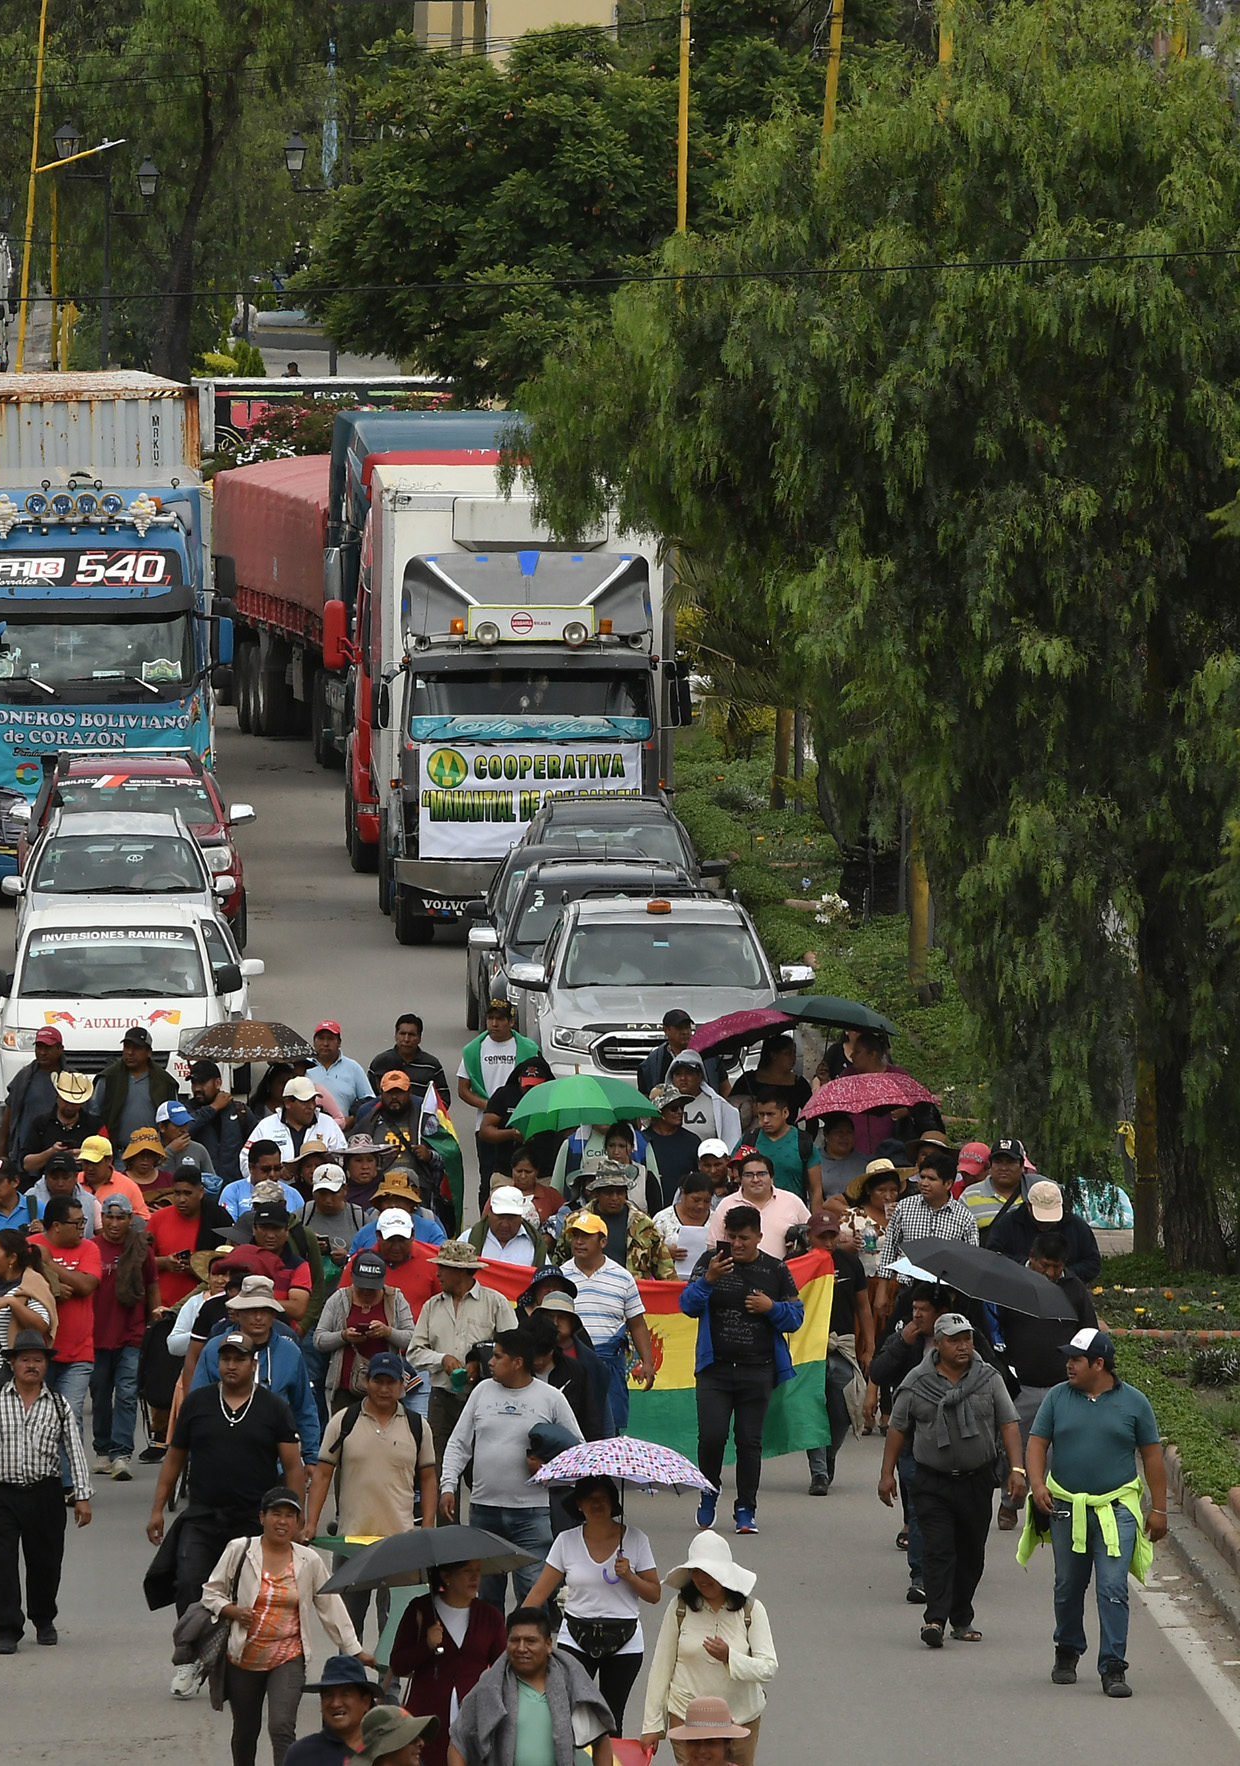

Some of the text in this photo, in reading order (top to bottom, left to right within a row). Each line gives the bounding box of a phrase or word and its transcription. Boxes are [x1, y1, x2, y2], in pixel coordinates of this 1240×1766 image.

[75, 554, 166, 583] 540
[3, 729, 126, 746] de CORAZÓN
[474, 754, 626, 780] COOPERATIVA
[520, 790, 541, 823] DE
[41, 930, 184, 943] INVERSIONES RAMIREZ
[83, 1018, 140, 1029] AUXILIO
